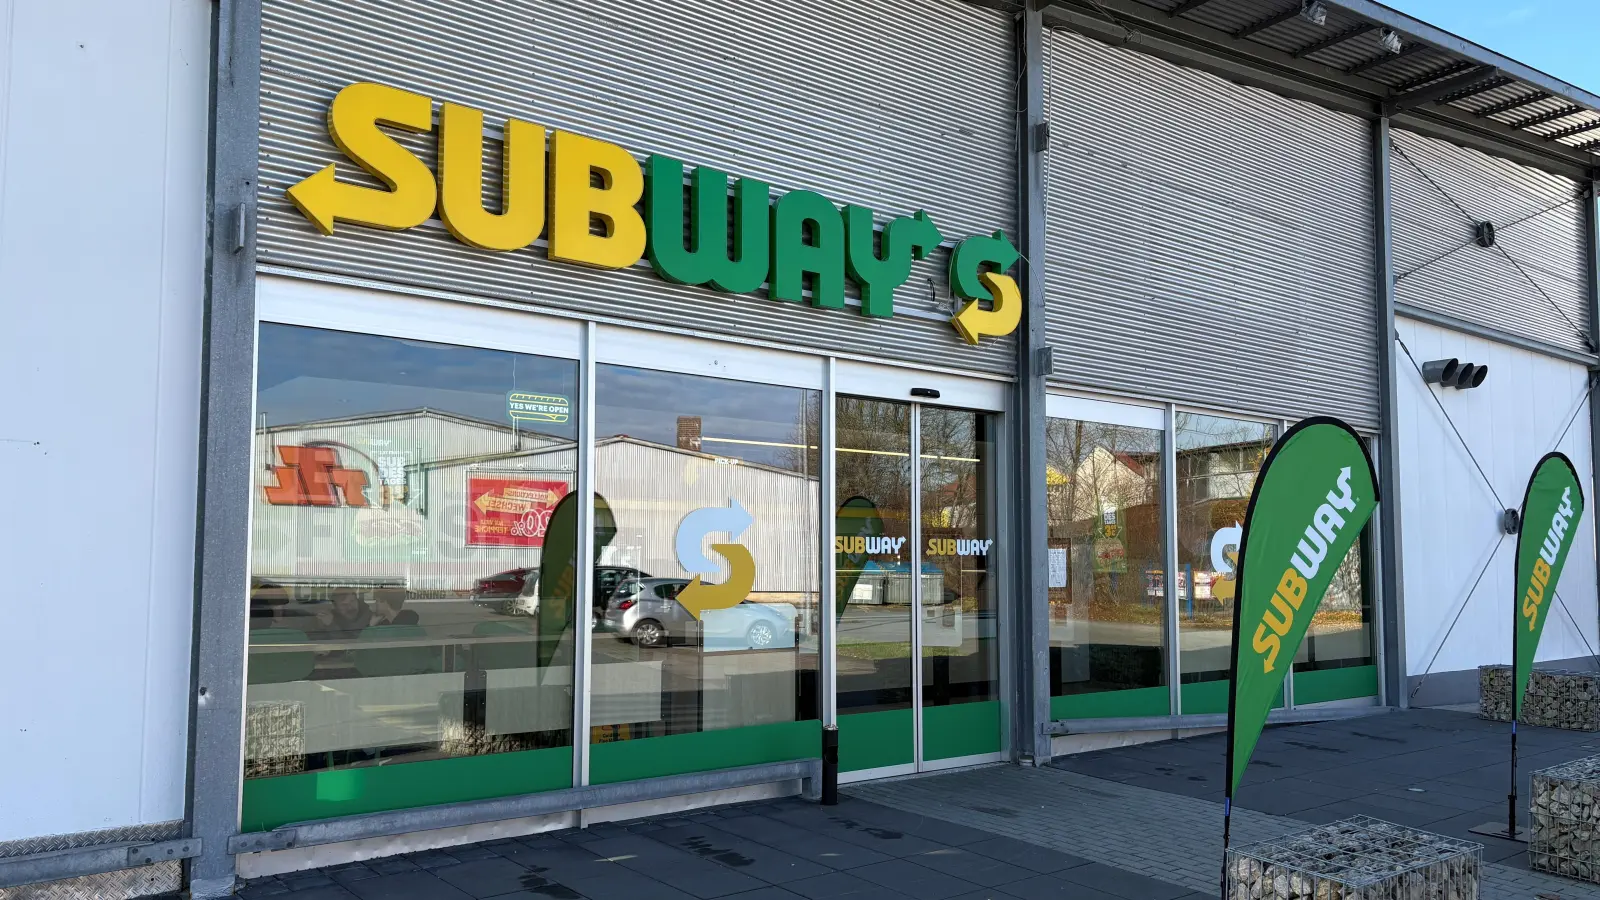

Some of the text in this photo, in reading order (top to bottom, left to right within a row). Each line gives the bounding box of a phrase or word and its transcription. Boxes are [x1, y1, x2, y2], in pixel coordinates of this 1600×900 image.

[286, 81, 943, 318] SUBWAY
[509, 402, 569, 414] YES WE'RE OPEN
[377, 456, 406, 467] SUB
[714, 457, 739, 465] PICK-UP
[378, 467, 407, 478] DES
[925, 538, 993, 556] SUBWAY
[1522, 486, 1575, 632] SUBWAY
[1252, 466, 1357, 674] SUBWAY
